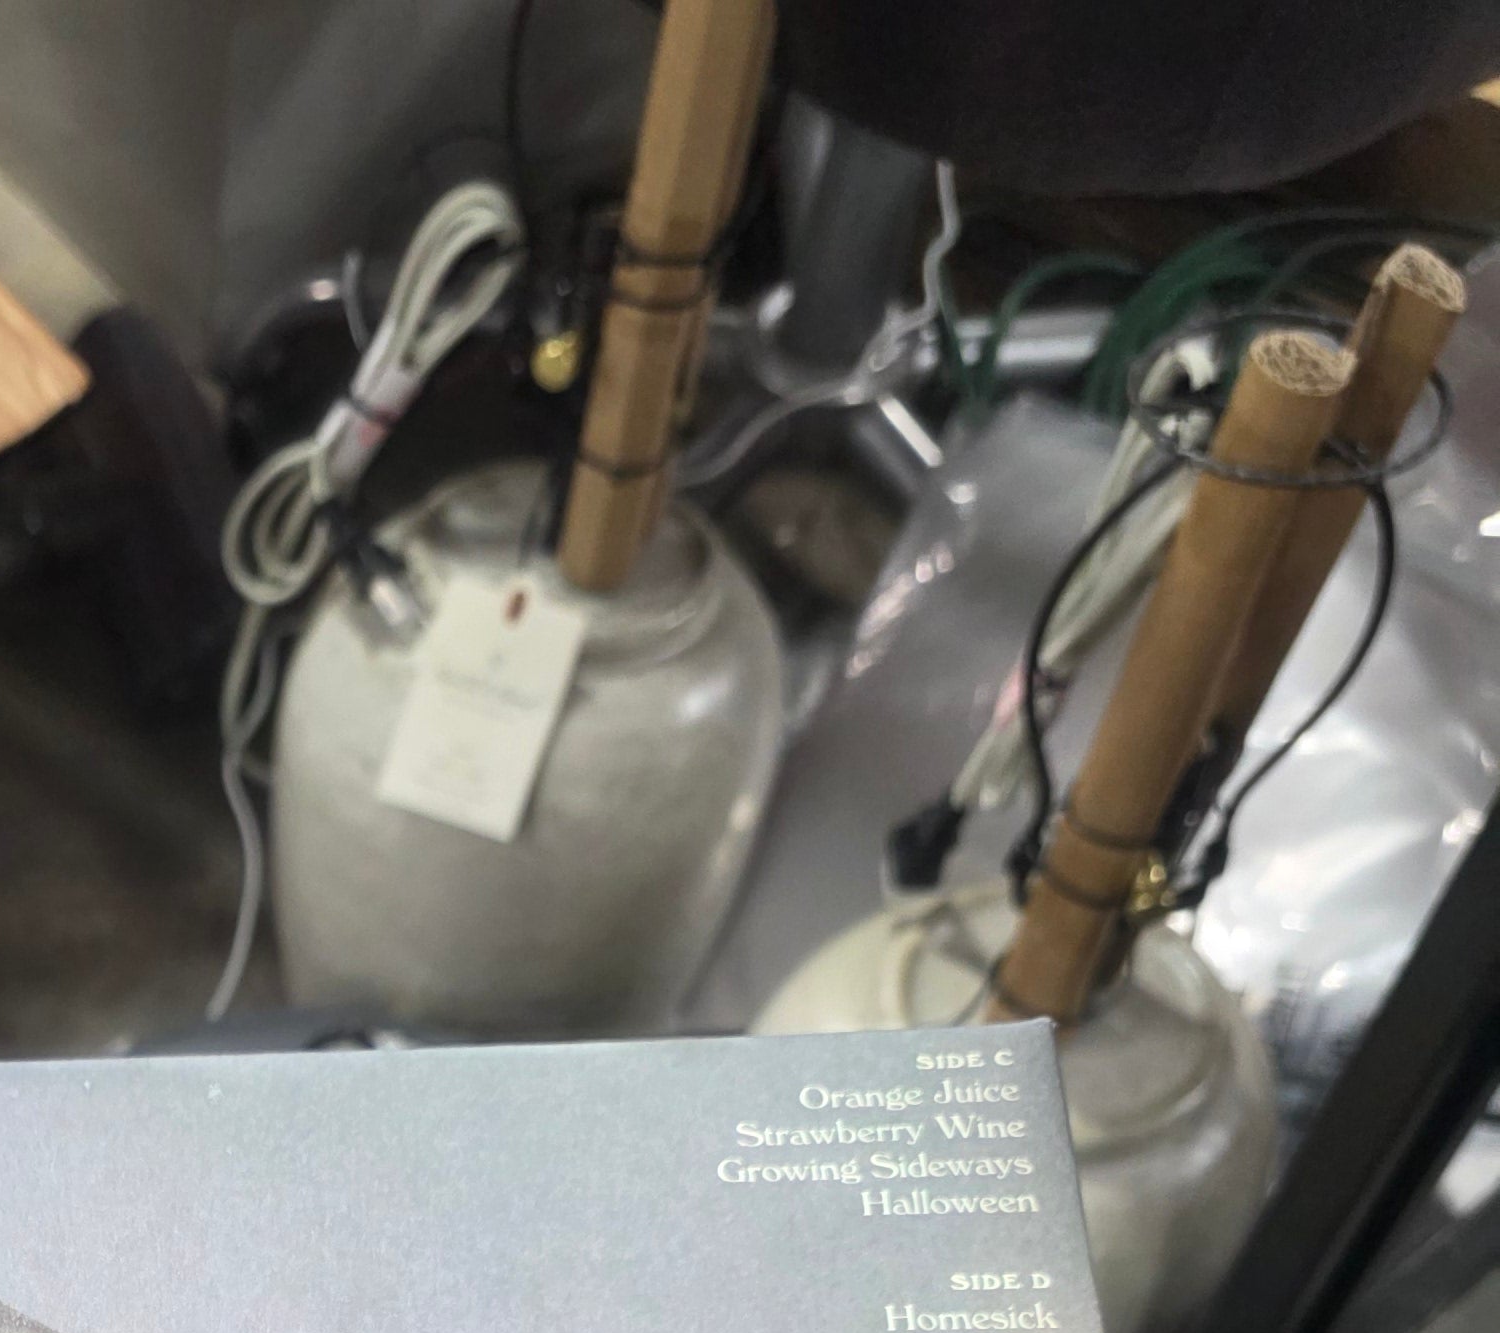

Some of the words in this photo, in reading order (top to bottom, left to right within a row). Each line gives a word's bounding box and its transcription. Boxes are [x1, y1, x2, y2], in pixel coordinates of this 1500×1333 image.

[916, 1052, 985, 1071] SIDE
[994, 1050, 1015, 1067] C
[799, 1085, 923, 1112] Orange
[933, 1079, 1020, 1104] Juice
[736, 1118, 923, 1148] Strawberry
[934, 1113, 1026, 1139] Wine
[717, 1159, 861, 1184] Growing
[871, 1151, 1034, 1180] Sideways
[861, 1190, 1039, 1217] Halloween
[951, 1273, 1021, 1291] SIDE
[1032, 1273, 1051, 1290] D
[885, 1303, 1059, 1332] Homesick
